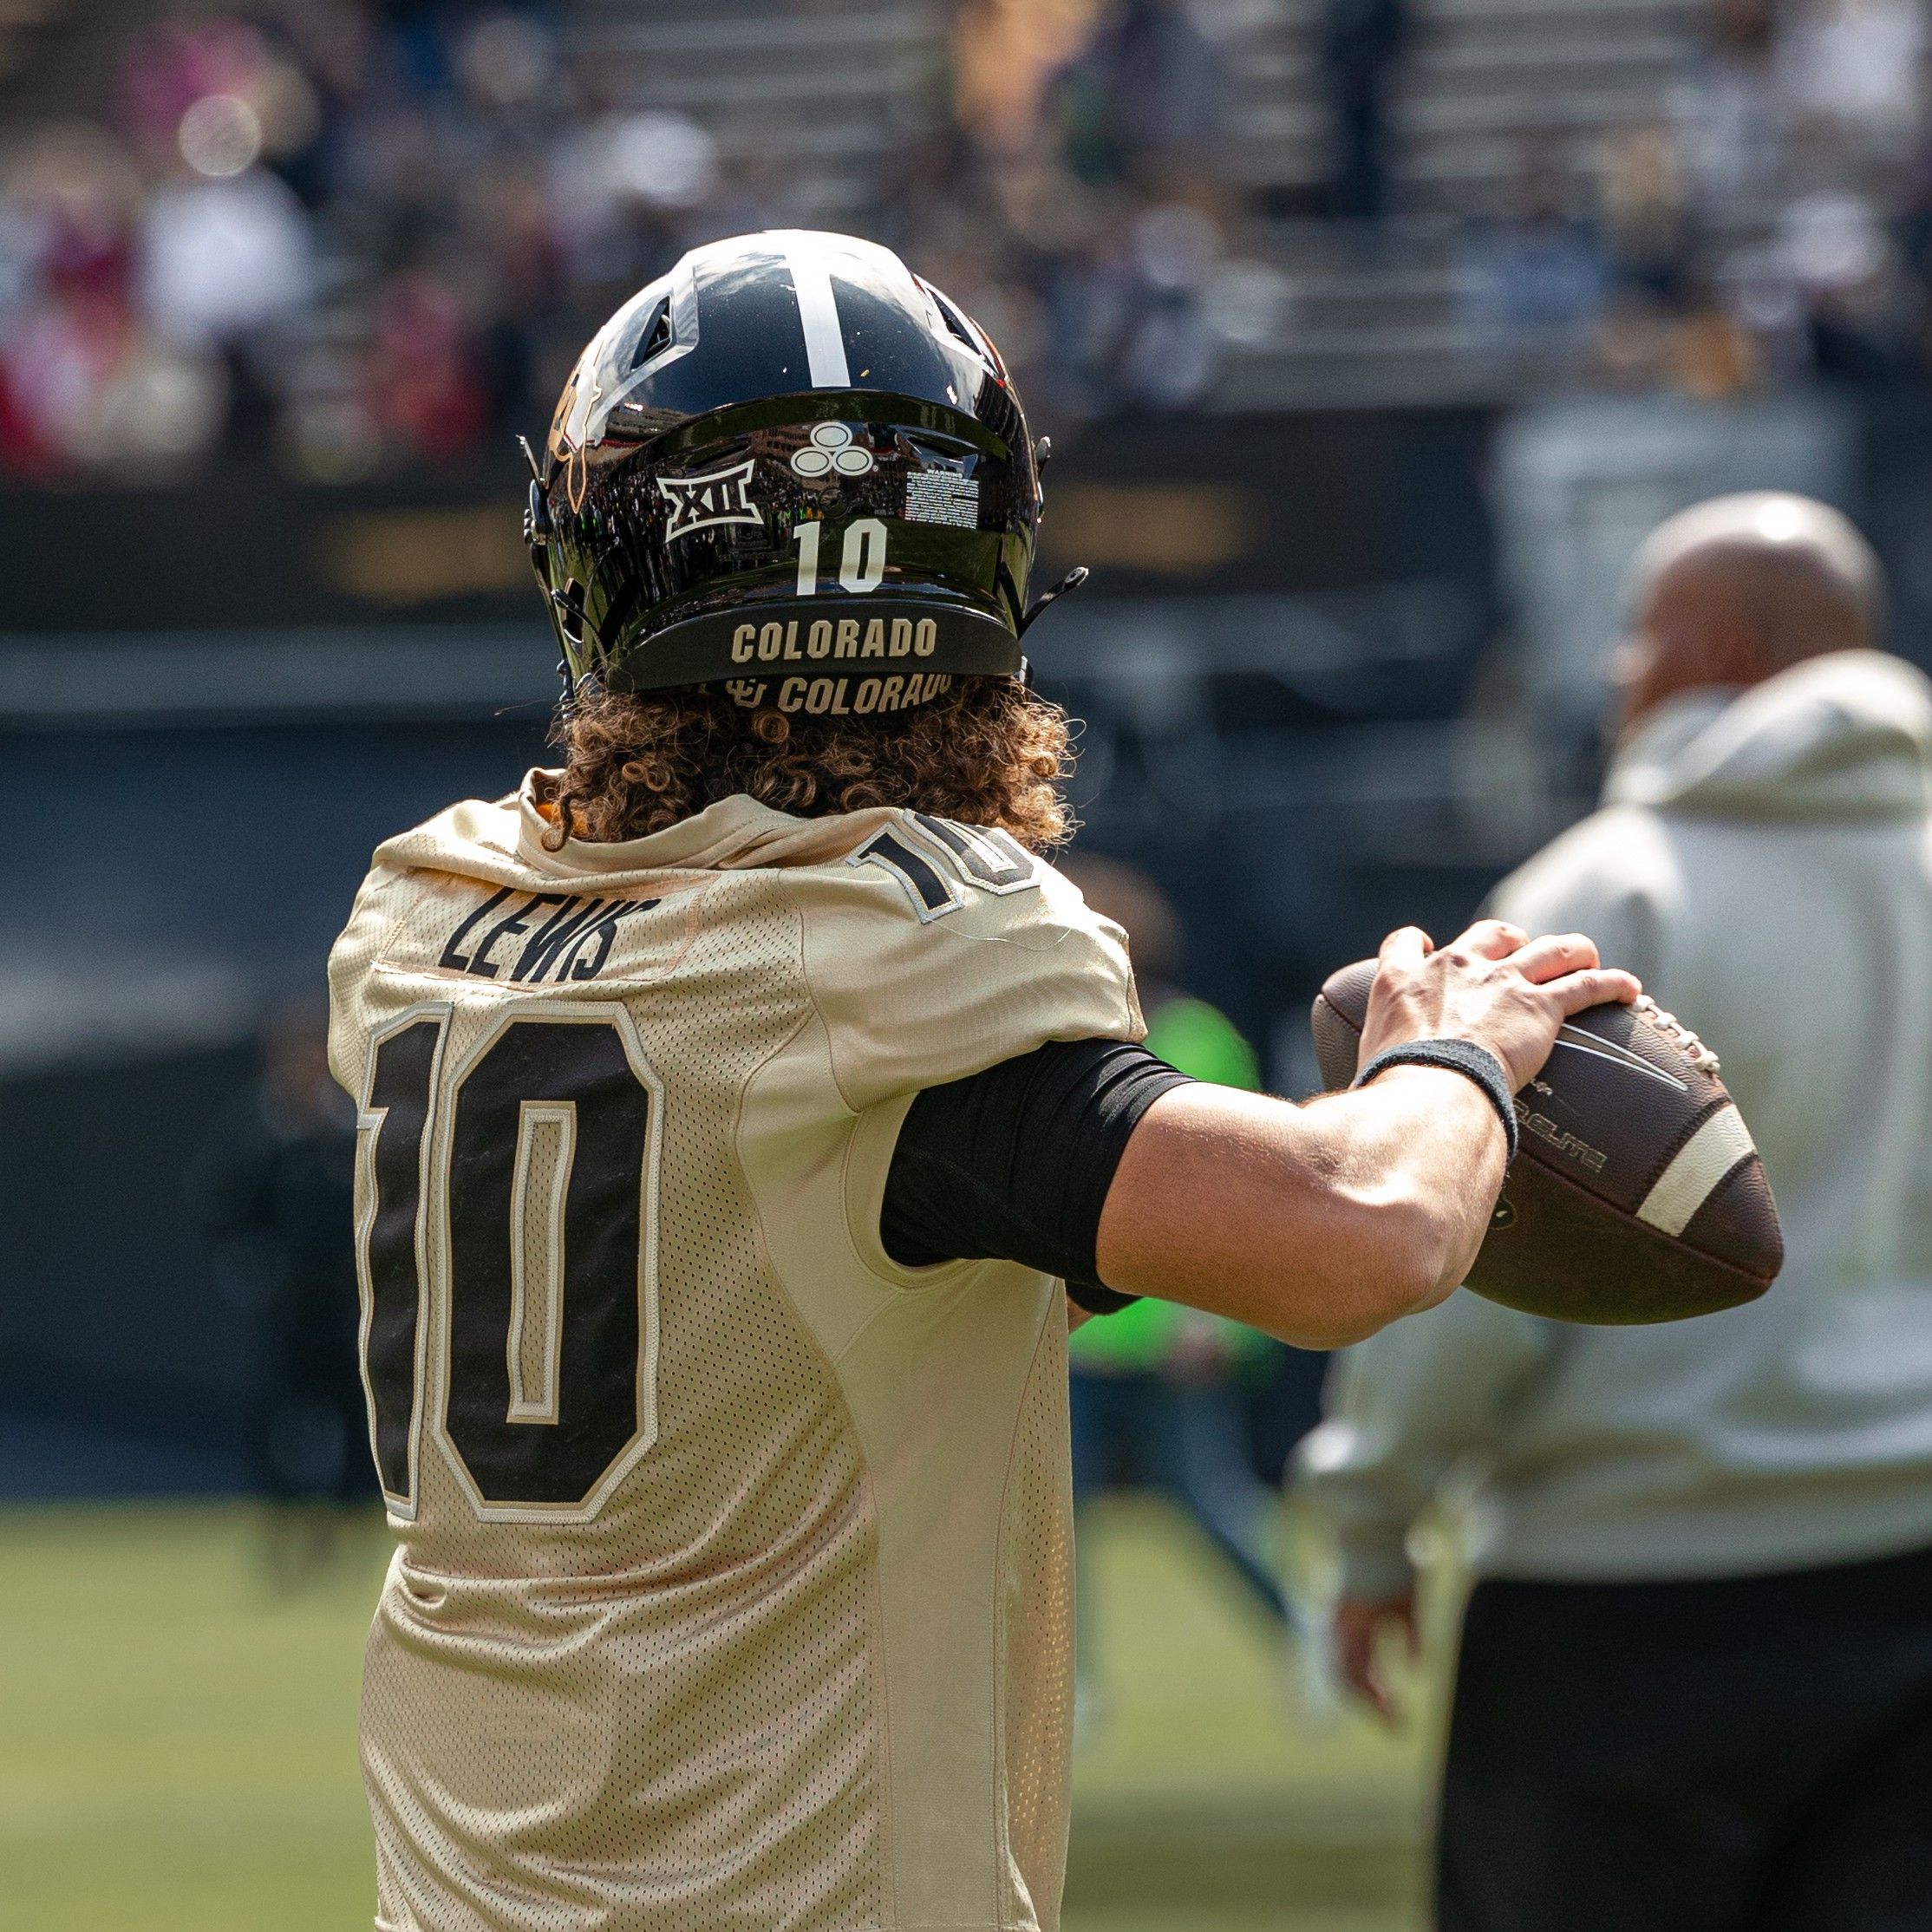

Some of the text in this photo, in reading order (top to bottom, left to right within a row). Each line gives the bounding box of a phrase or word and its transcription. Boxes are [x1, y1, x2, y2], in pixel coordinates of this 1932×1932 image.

[656, 459, 764, 543] XII
[927, 469, 963, 479] WARNING
[793, 518, 888, 596] 10
[731, 618, 937, 663] COLORADO
[845, 807, 1041, 924] 10
[438, 886, 644, 982] LEWIS
[356, 1001, 663, 1524] 10
